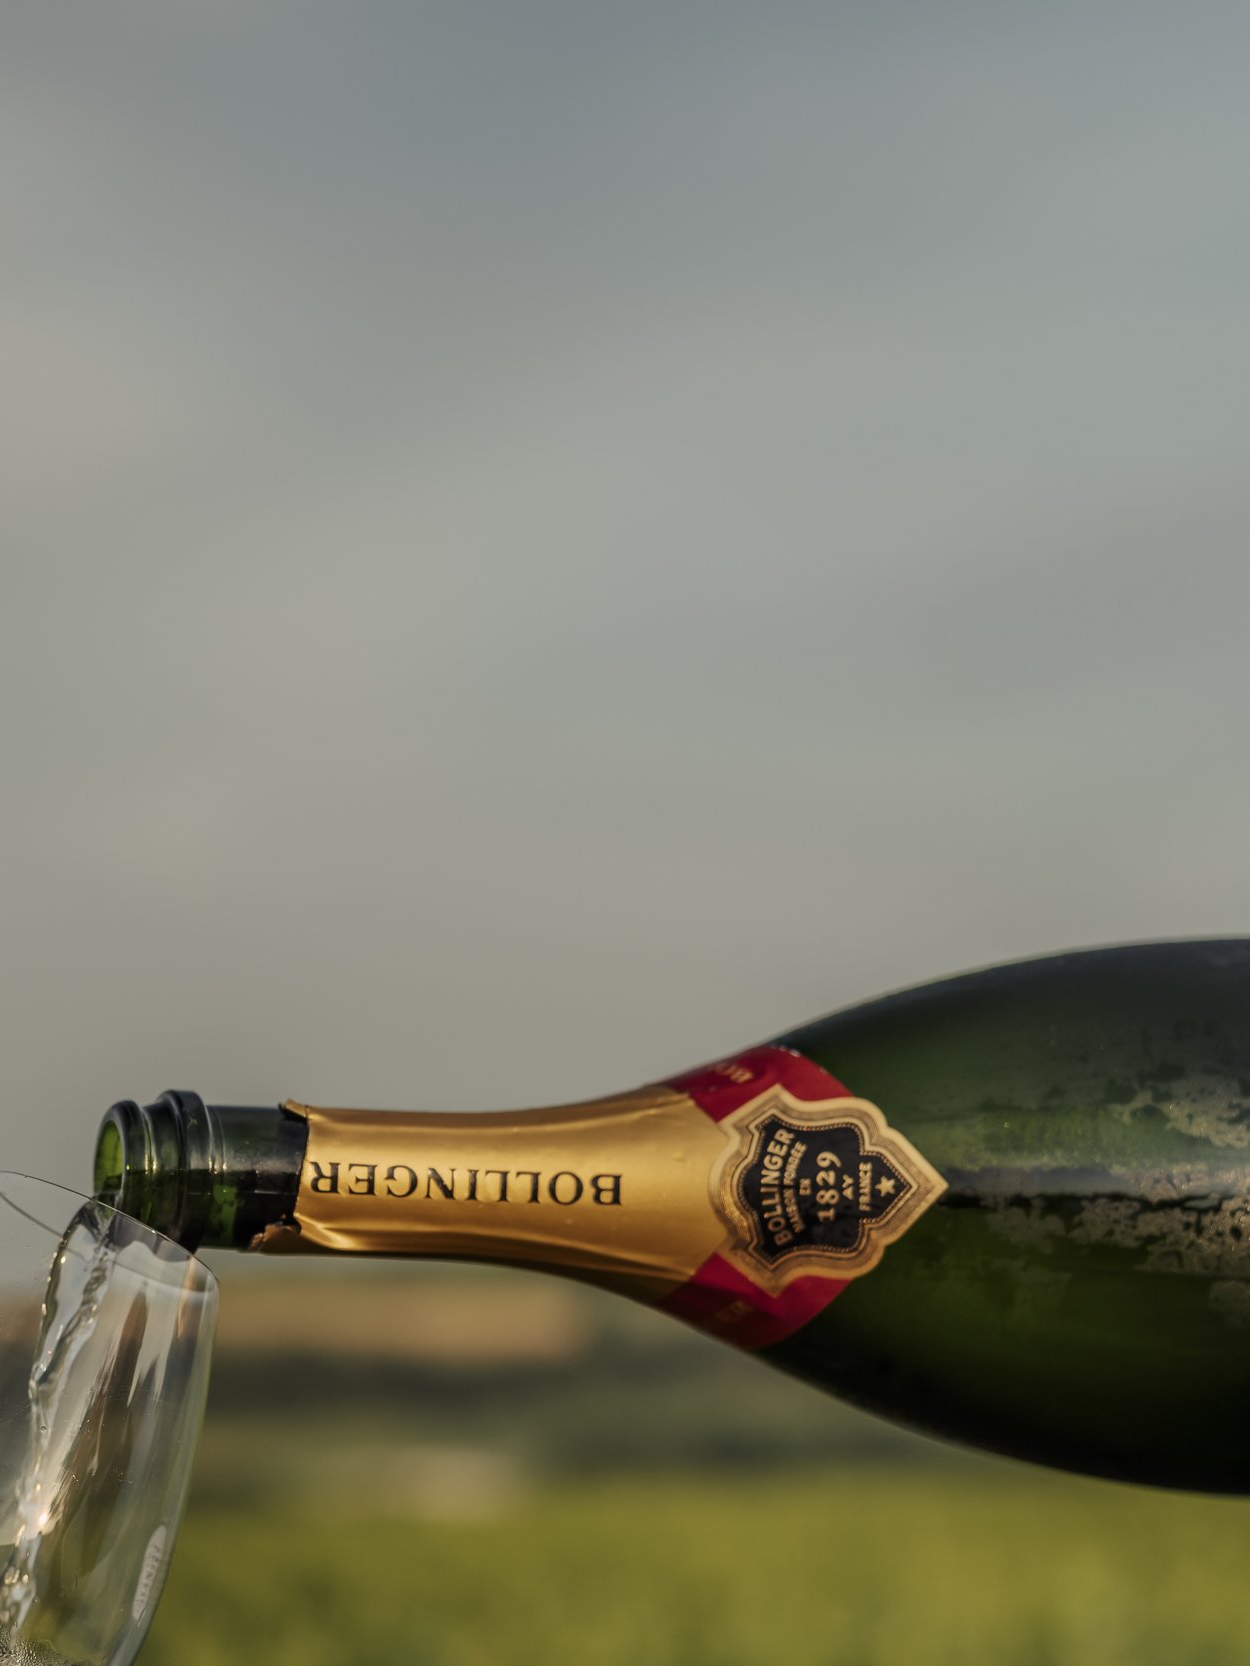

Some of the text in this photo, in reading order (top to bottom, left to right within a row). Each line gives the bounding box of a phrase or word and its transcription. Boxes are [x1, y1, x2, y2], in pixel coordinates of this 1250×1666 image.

[310, 1162, 623, 1206] BOLLINGER
[760, 1129, 795, 1246] BOLLINGER
[816, 1151, 842, 1222] 1829
[859, 1162, 872, 1211] FRANCE
